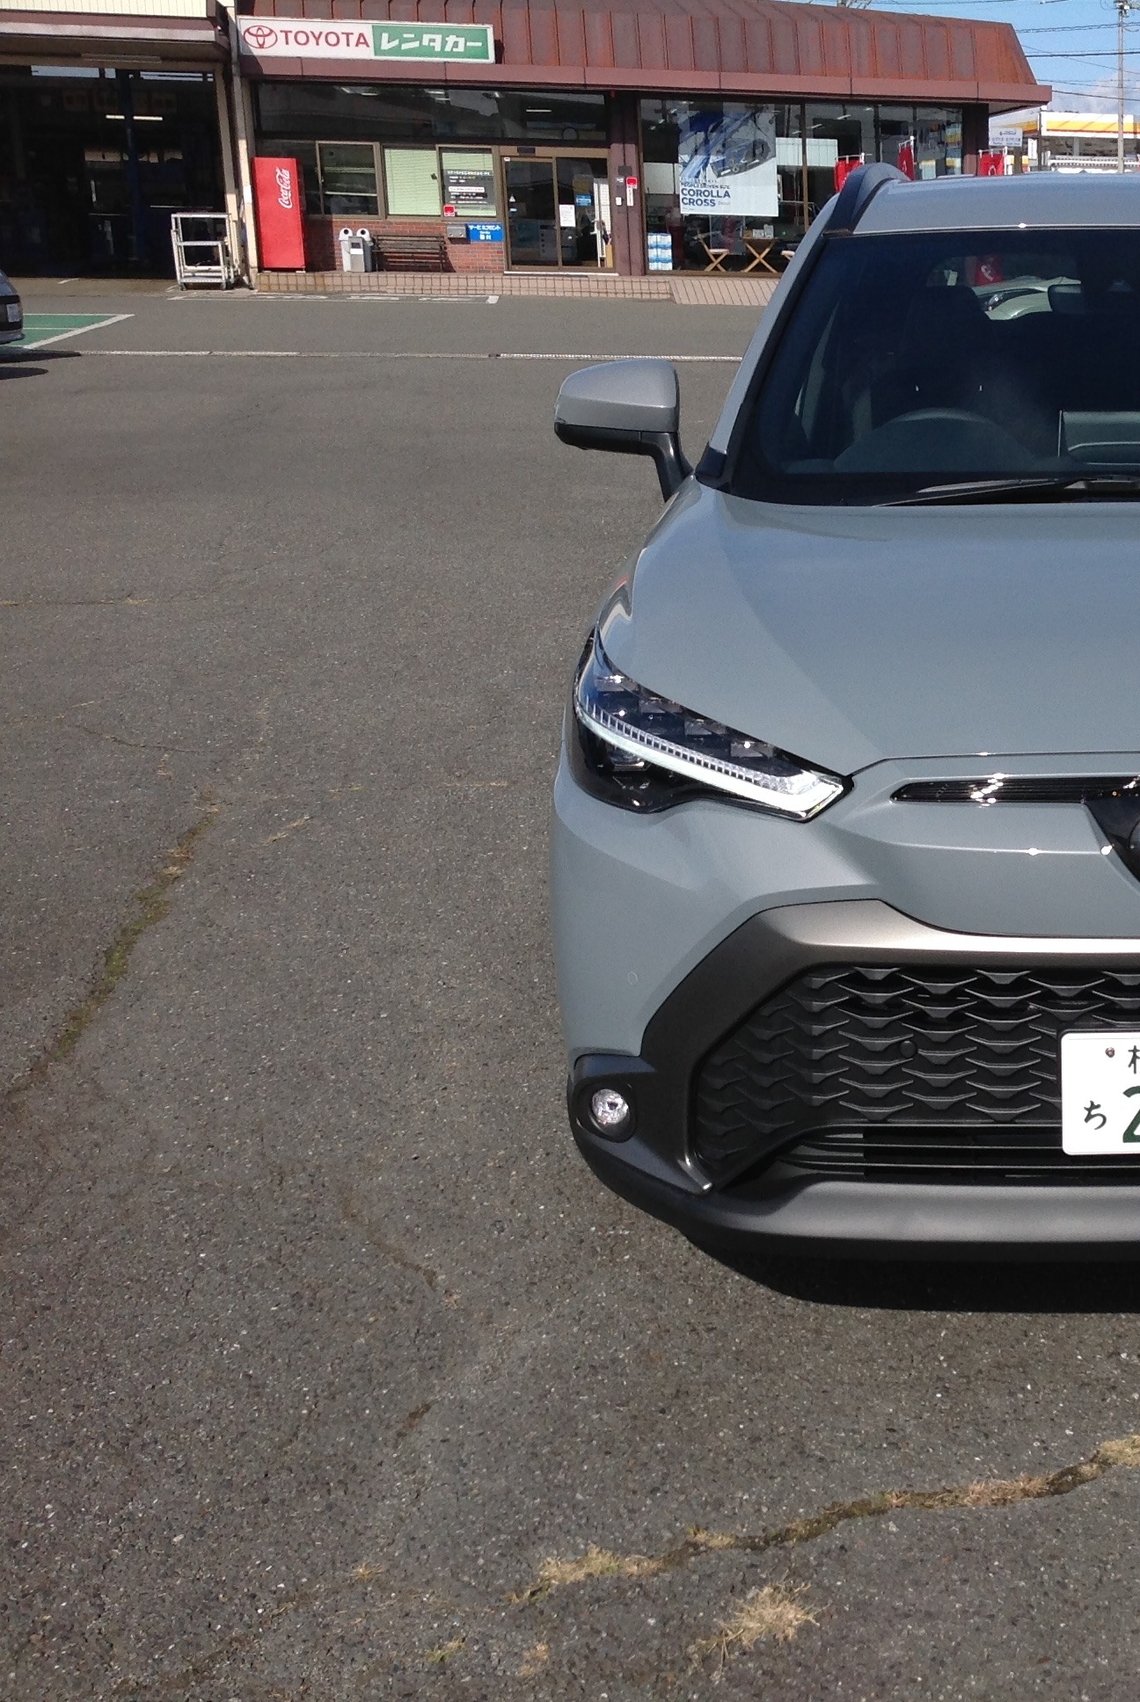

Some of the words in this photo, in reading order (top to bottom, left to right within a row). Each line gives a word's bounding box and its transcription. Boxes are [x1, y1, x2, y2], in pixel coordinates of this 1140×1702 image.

[280, 30, 370, 48] TOYOTA
[381, 32, 482, 52] レンタカー
[681, 188, 731, 199] COROLLA
[681, 197, 716, 207] CROSS
[1083, 1100, 1107, 1130] ち
